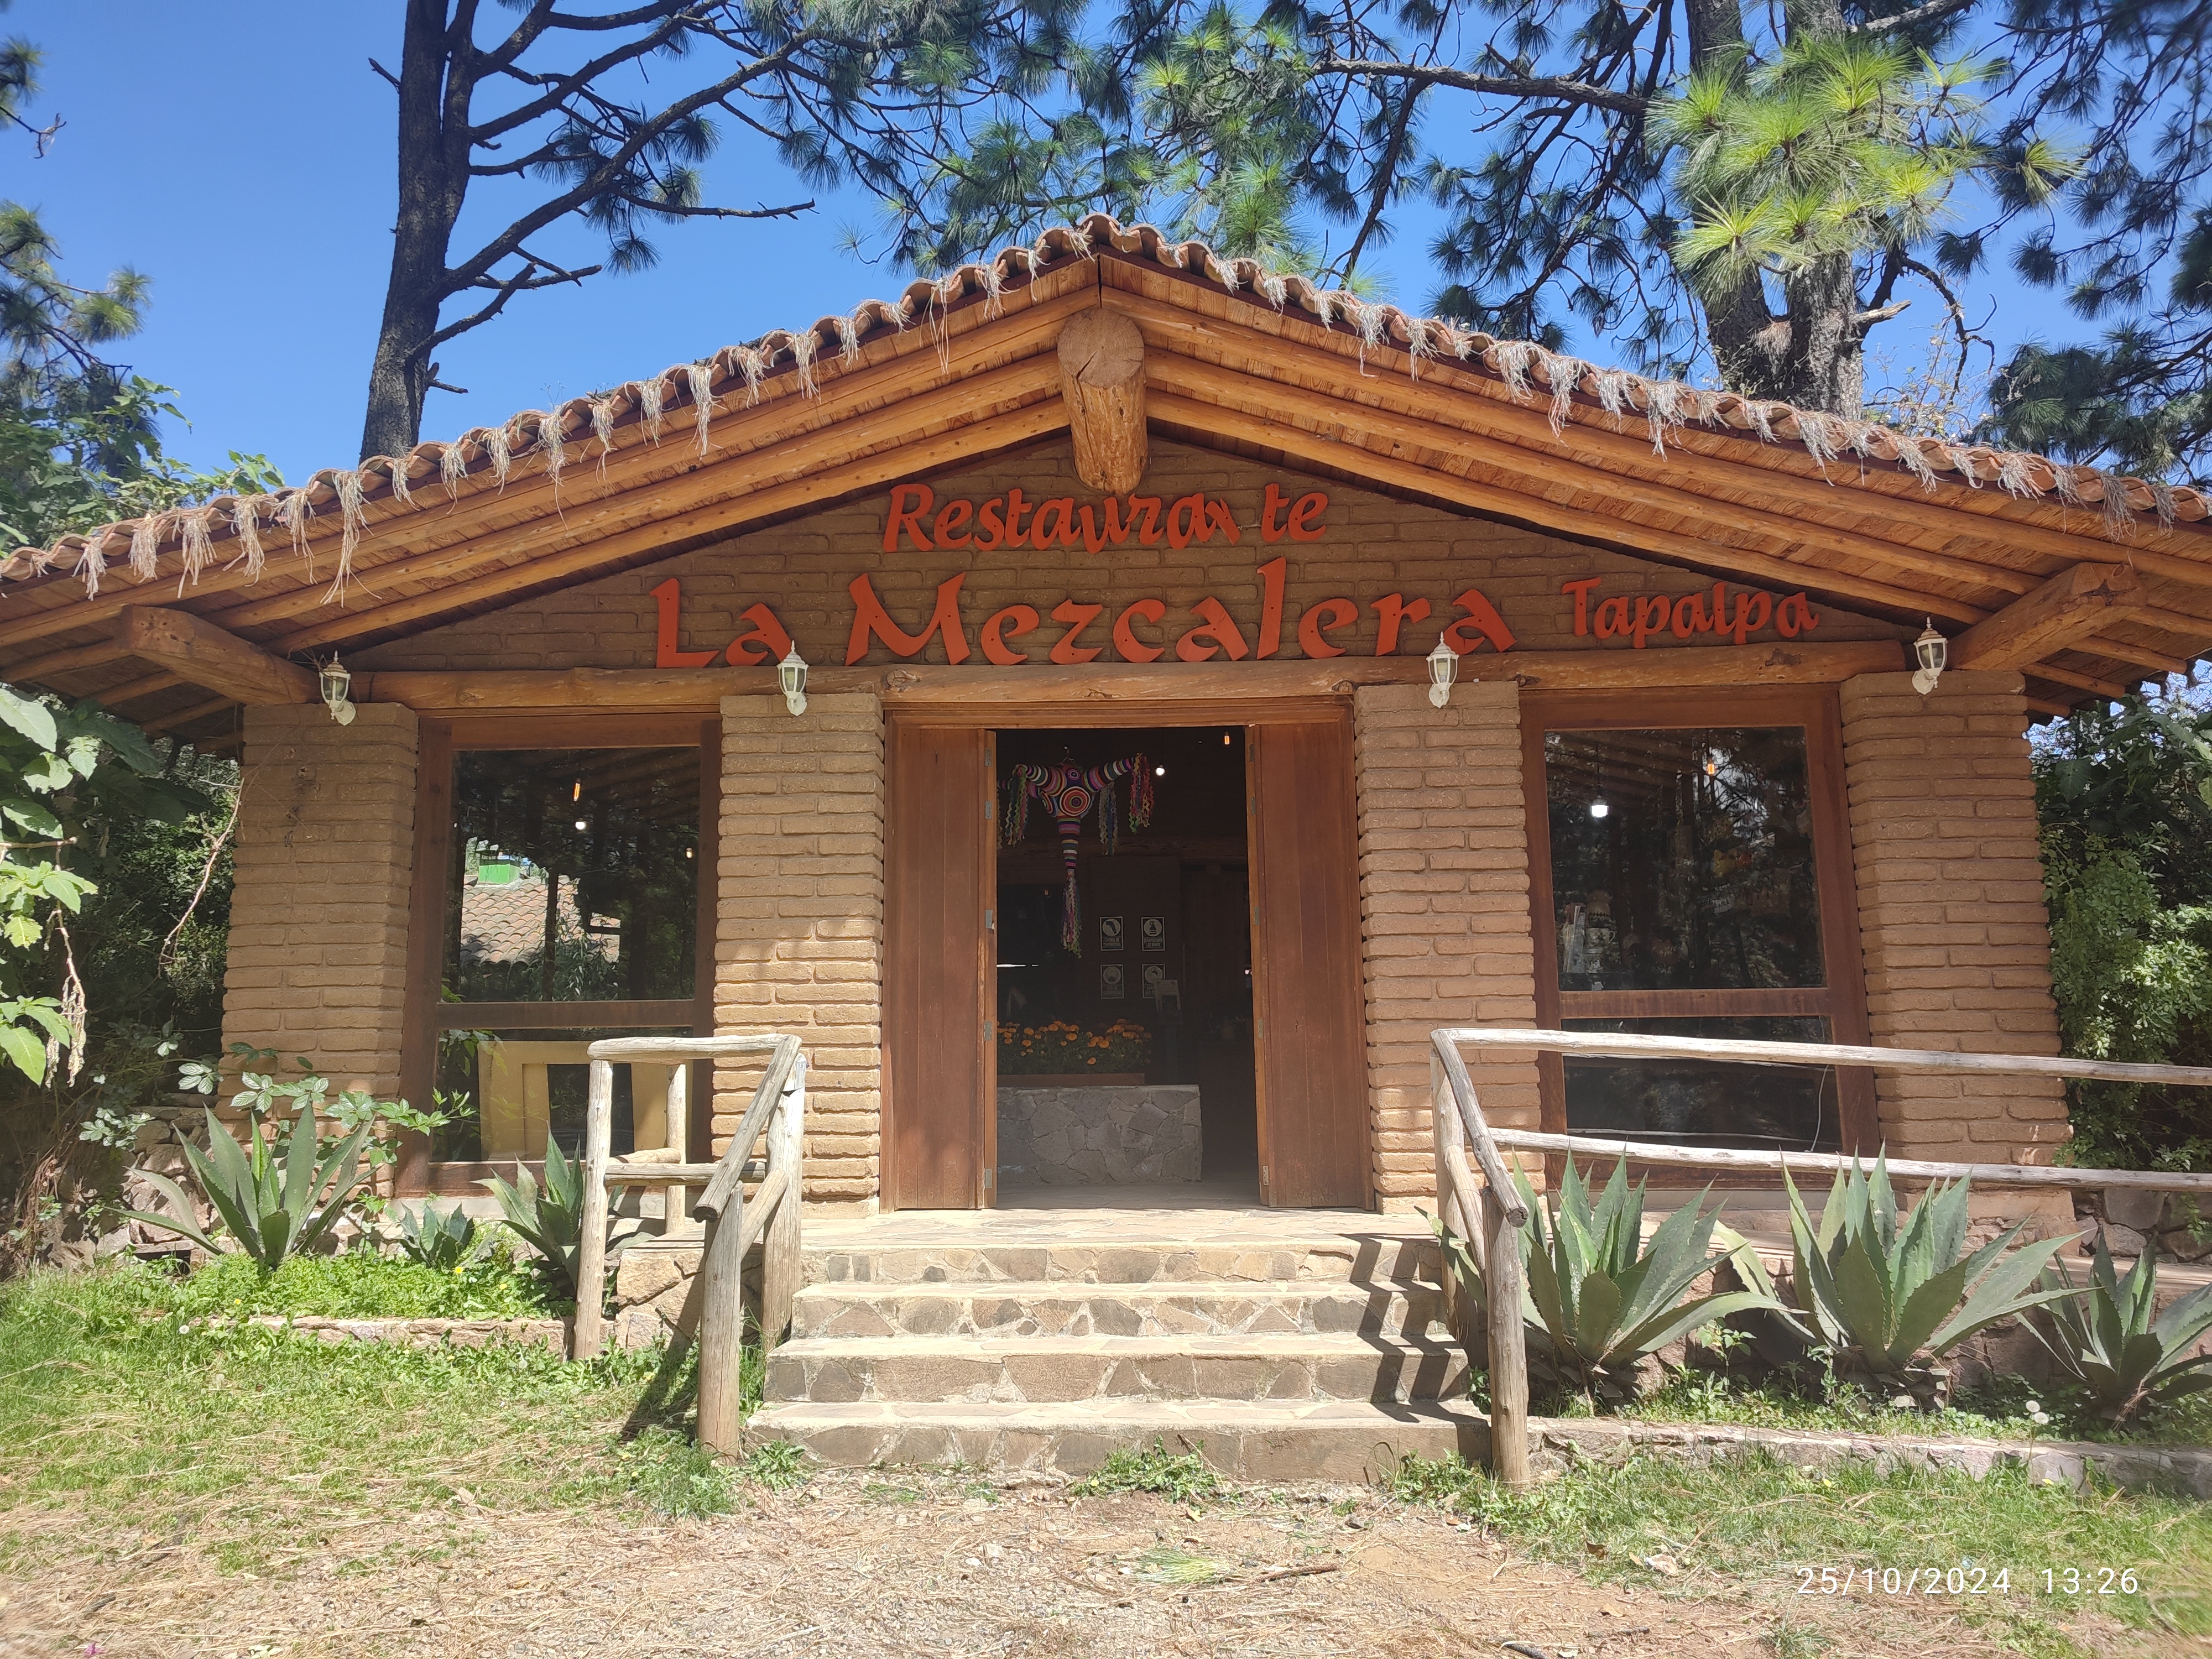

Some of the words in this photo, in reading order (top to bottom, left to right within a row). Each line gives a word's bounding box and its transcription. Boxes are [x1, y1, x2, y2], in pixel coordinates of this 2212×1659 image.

[649, 577, 794, 667] La
[845, 556, 1517, 666] Mezcalera
[1562, 577, 1819, 649] Tapalpa
